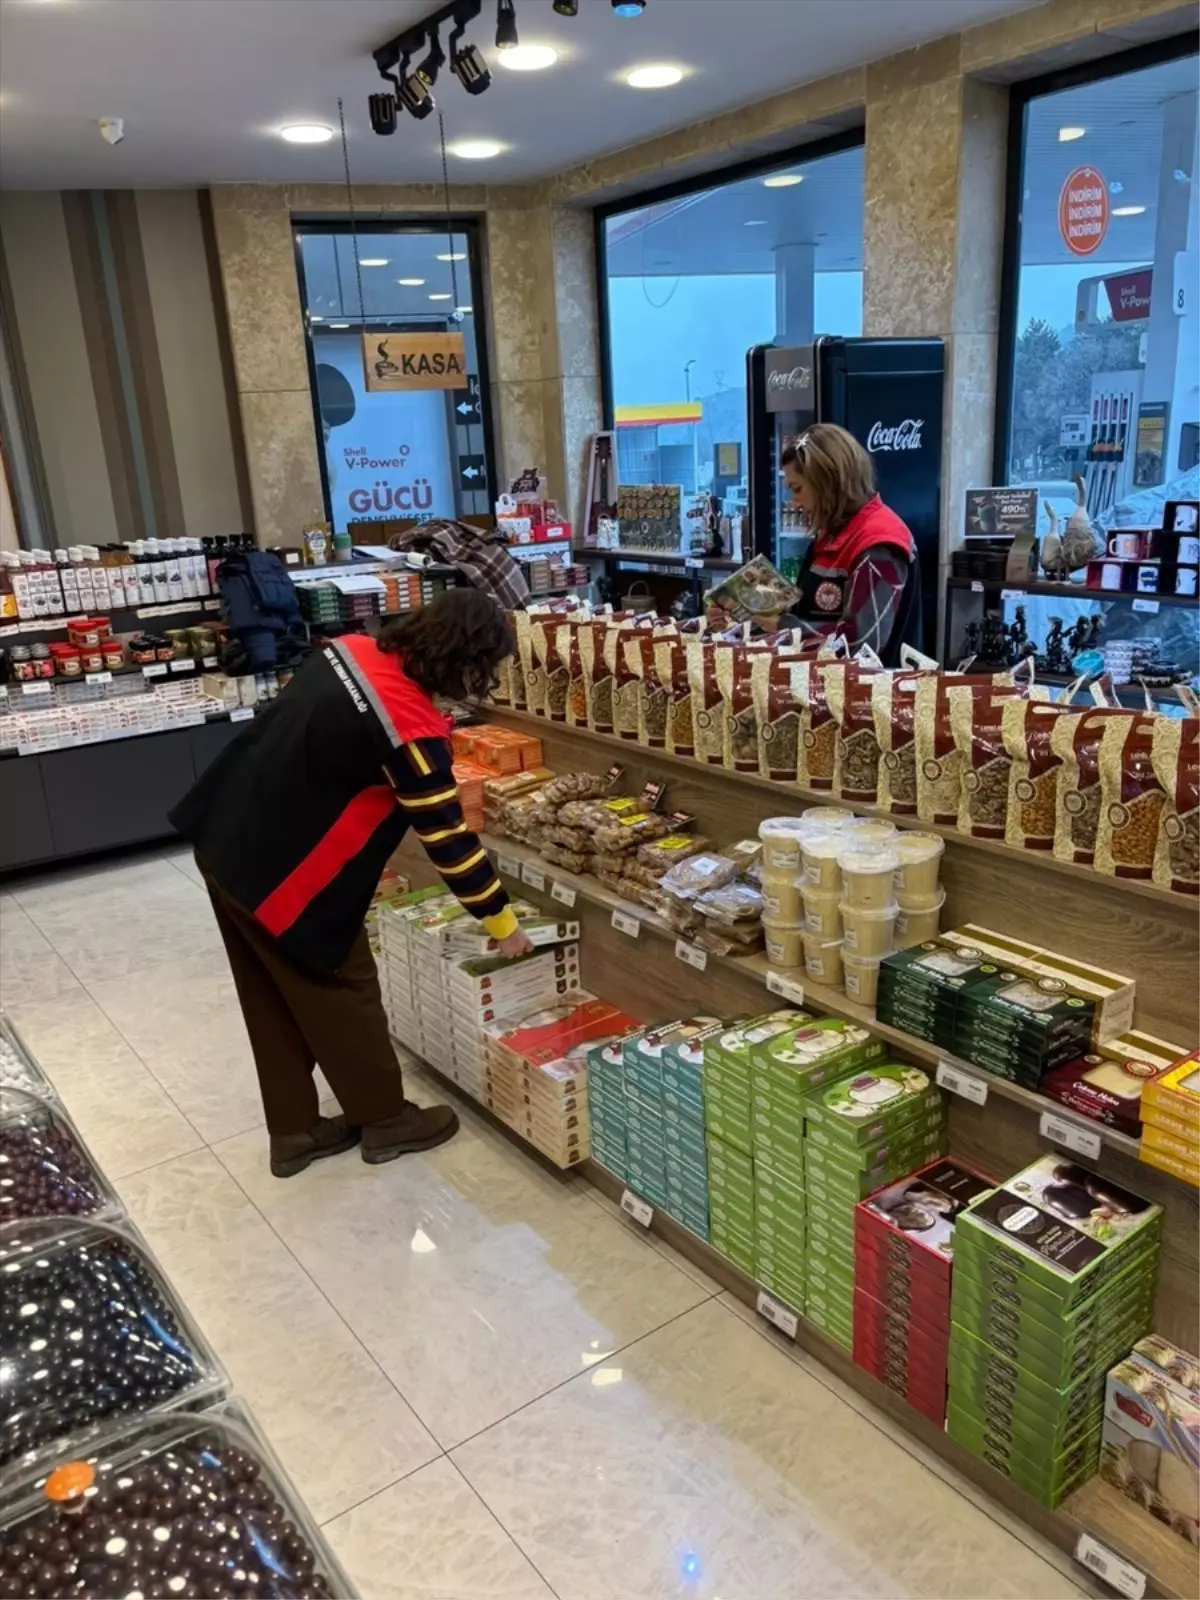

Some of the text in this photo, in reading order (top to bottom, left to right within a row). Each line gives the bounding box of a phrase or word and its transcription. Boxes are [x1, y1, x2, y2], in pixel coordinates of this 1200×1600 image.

[1177, 288, 1185, 309] 8
[401, 352, 462, 375] KASA
[343, 446, 367, 457] Shell
[344, 457, 406, 470] V-Power
[348, 478, 433, 513] GÜCÜ
